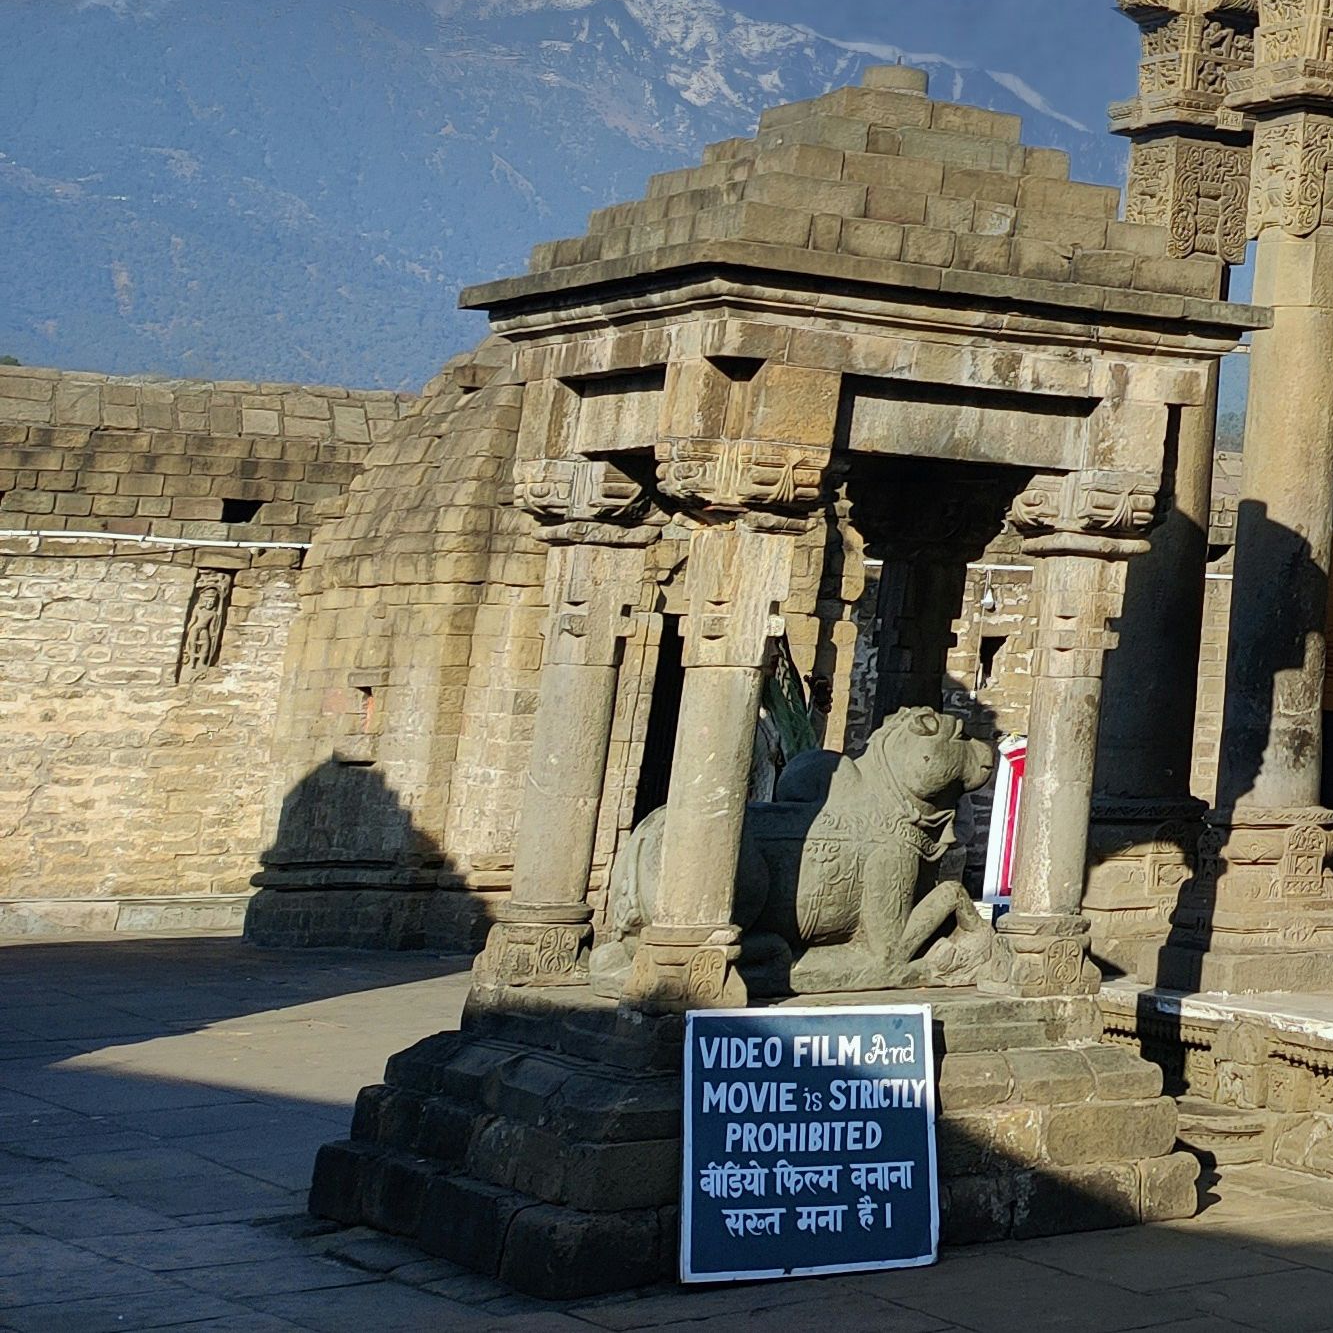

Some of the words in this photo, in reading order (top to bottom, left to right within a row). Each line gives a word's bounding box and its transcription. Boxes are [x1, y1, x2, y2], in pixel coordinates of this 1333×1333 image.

[700, 1036, 783, 1068] VIDEO
[793, 1035, 861, 1067] FILM
[864, 1033, 915, 1065] And
[702, 1082, 797, 1113] MOVIE
[802, 1087, 823, 1112] is
[828, 1079, 926, 1111] STRICTLY
[725, 1121, 882, 1153] PROHIBITED
[772, 1159, 844, 1196] फिल्म
[850, 1160, 915, 1193] बनाना
[795, 1204, 849, 1235] मना
